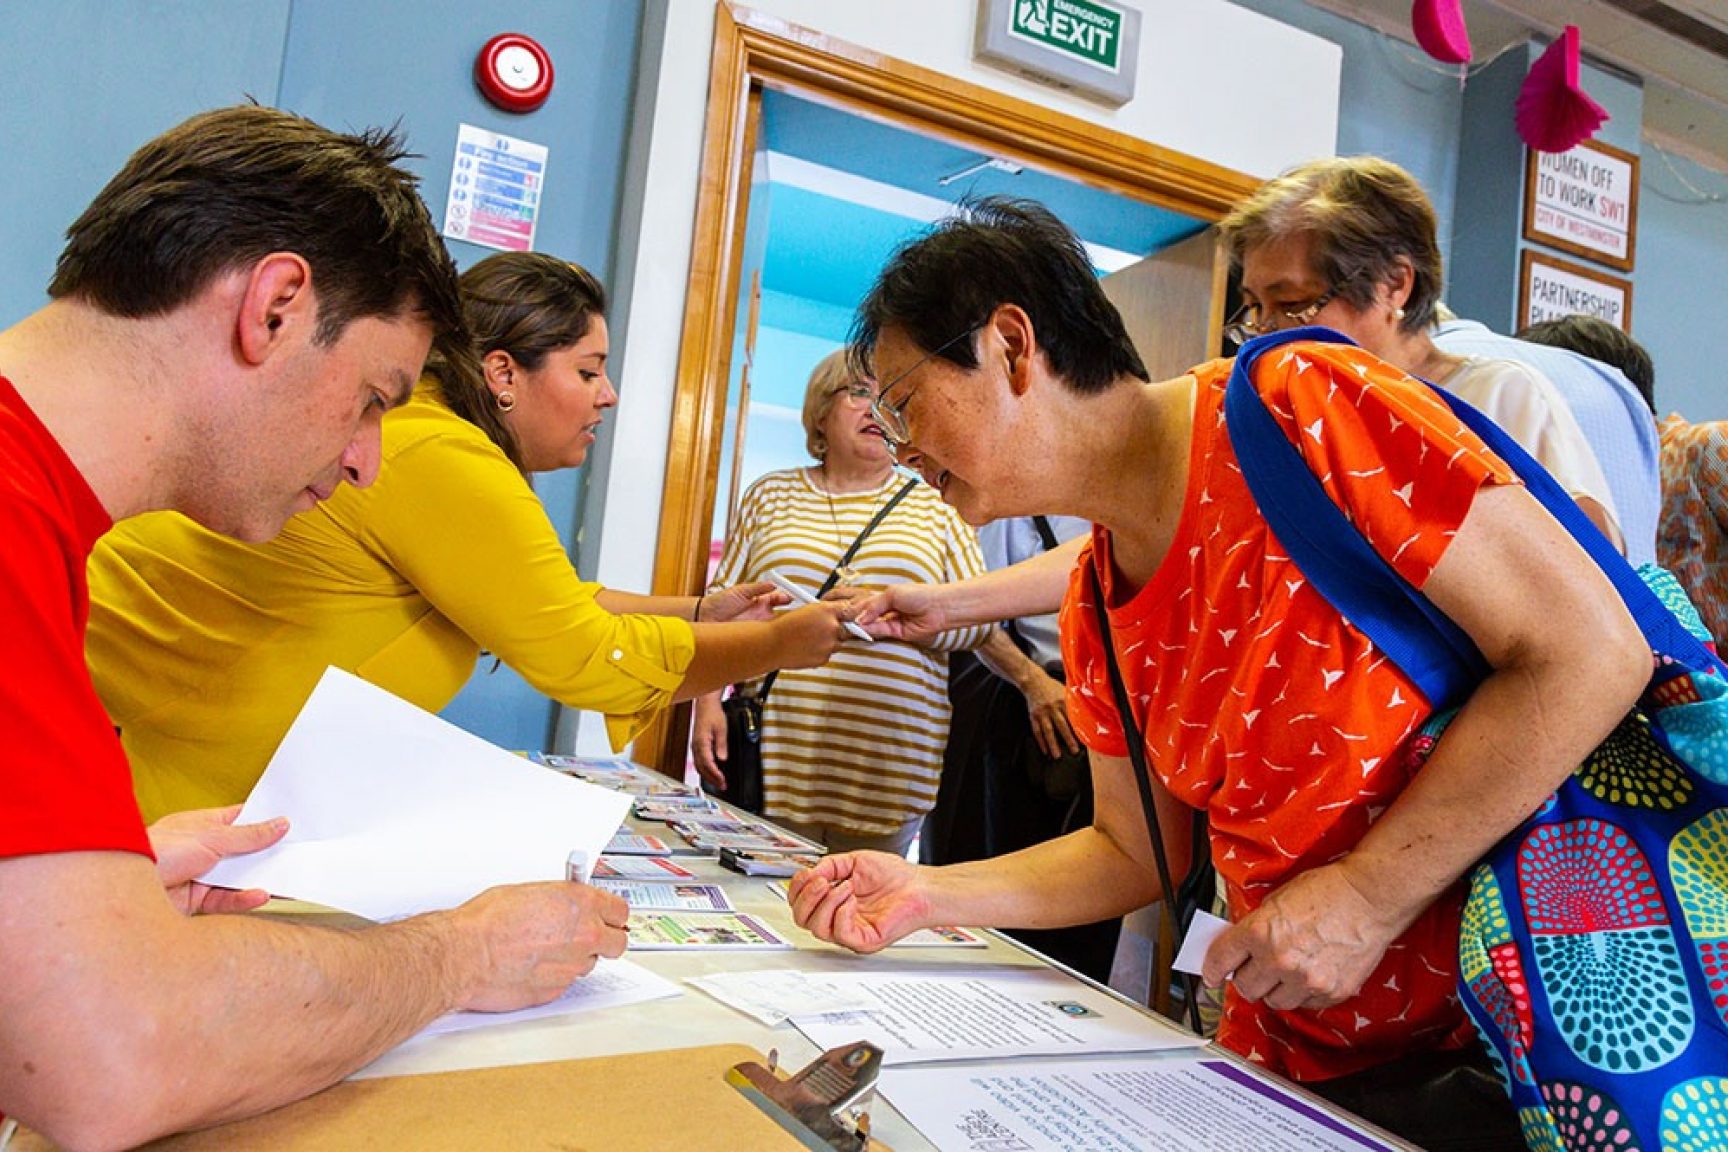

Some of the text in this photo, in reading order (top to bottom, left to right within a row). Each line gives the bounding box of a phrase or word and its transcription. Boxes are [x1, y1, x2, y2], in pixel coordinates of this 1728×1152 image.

[1051, 12, 1113, 55] EXIT
[1053, 0, 1114, 28] EMERGENCY
[1542, 152, 1613, 191] WOMEN OFF
[1540, 173, 1625, 224] TO WORK SW1
[1537, 208, 1620, 249] CITY OF WESTMINSTER
[1533, 276, 1620, 321] PARTNERSHIP
